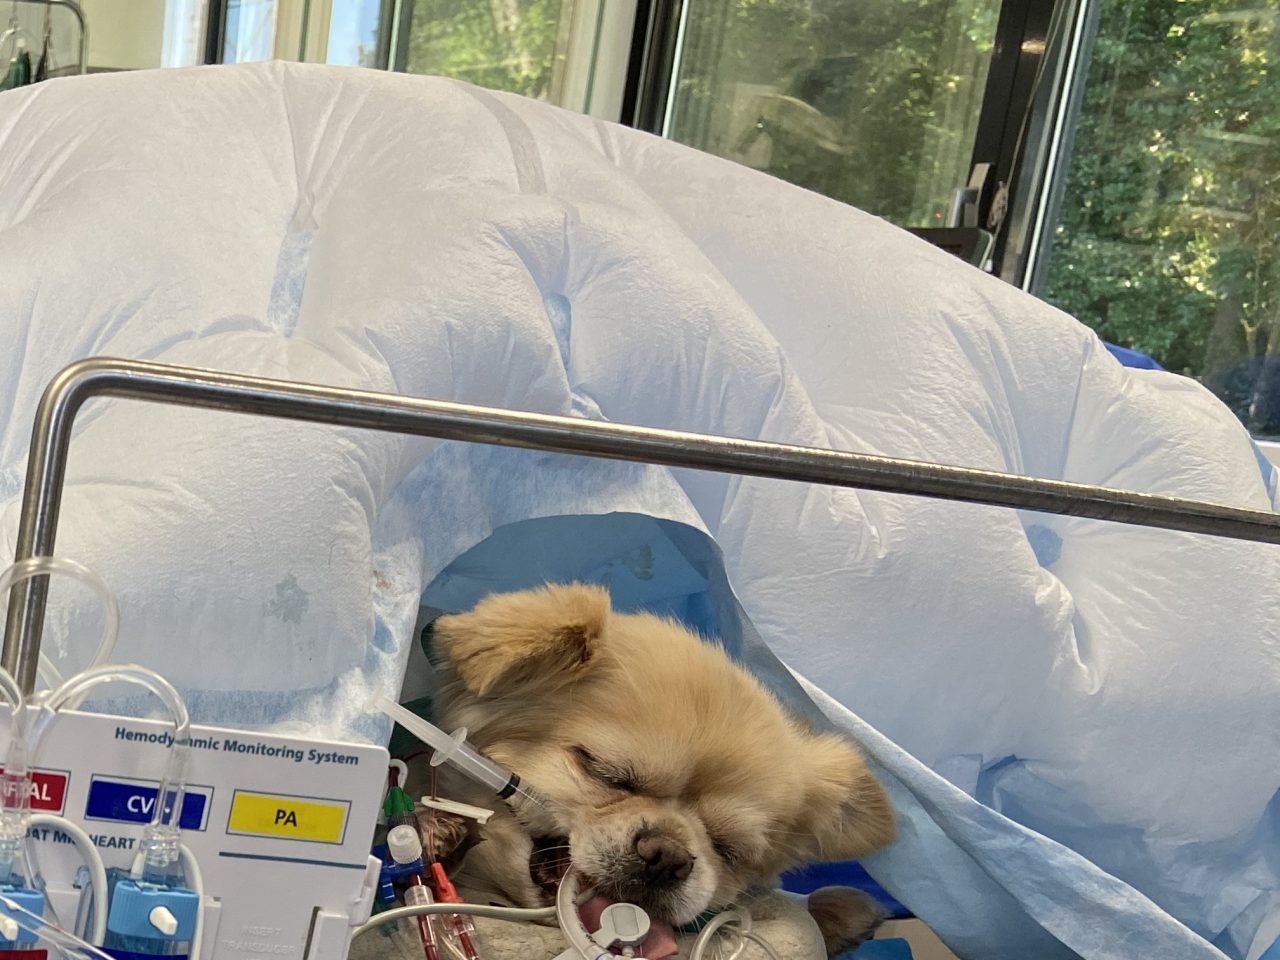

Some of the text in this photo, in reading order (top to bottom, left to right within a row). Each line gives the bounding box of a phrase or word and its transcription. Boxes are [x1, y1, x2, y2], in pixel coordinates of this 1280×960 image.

[114, 727, 360, 766] Hemodymic Monitoring System
[127, 795, 171, 815] CV
[274, 809, 298, 827] PA
[53, 830, 78, 845] MI
[88, 834, 136, 850] HEART
